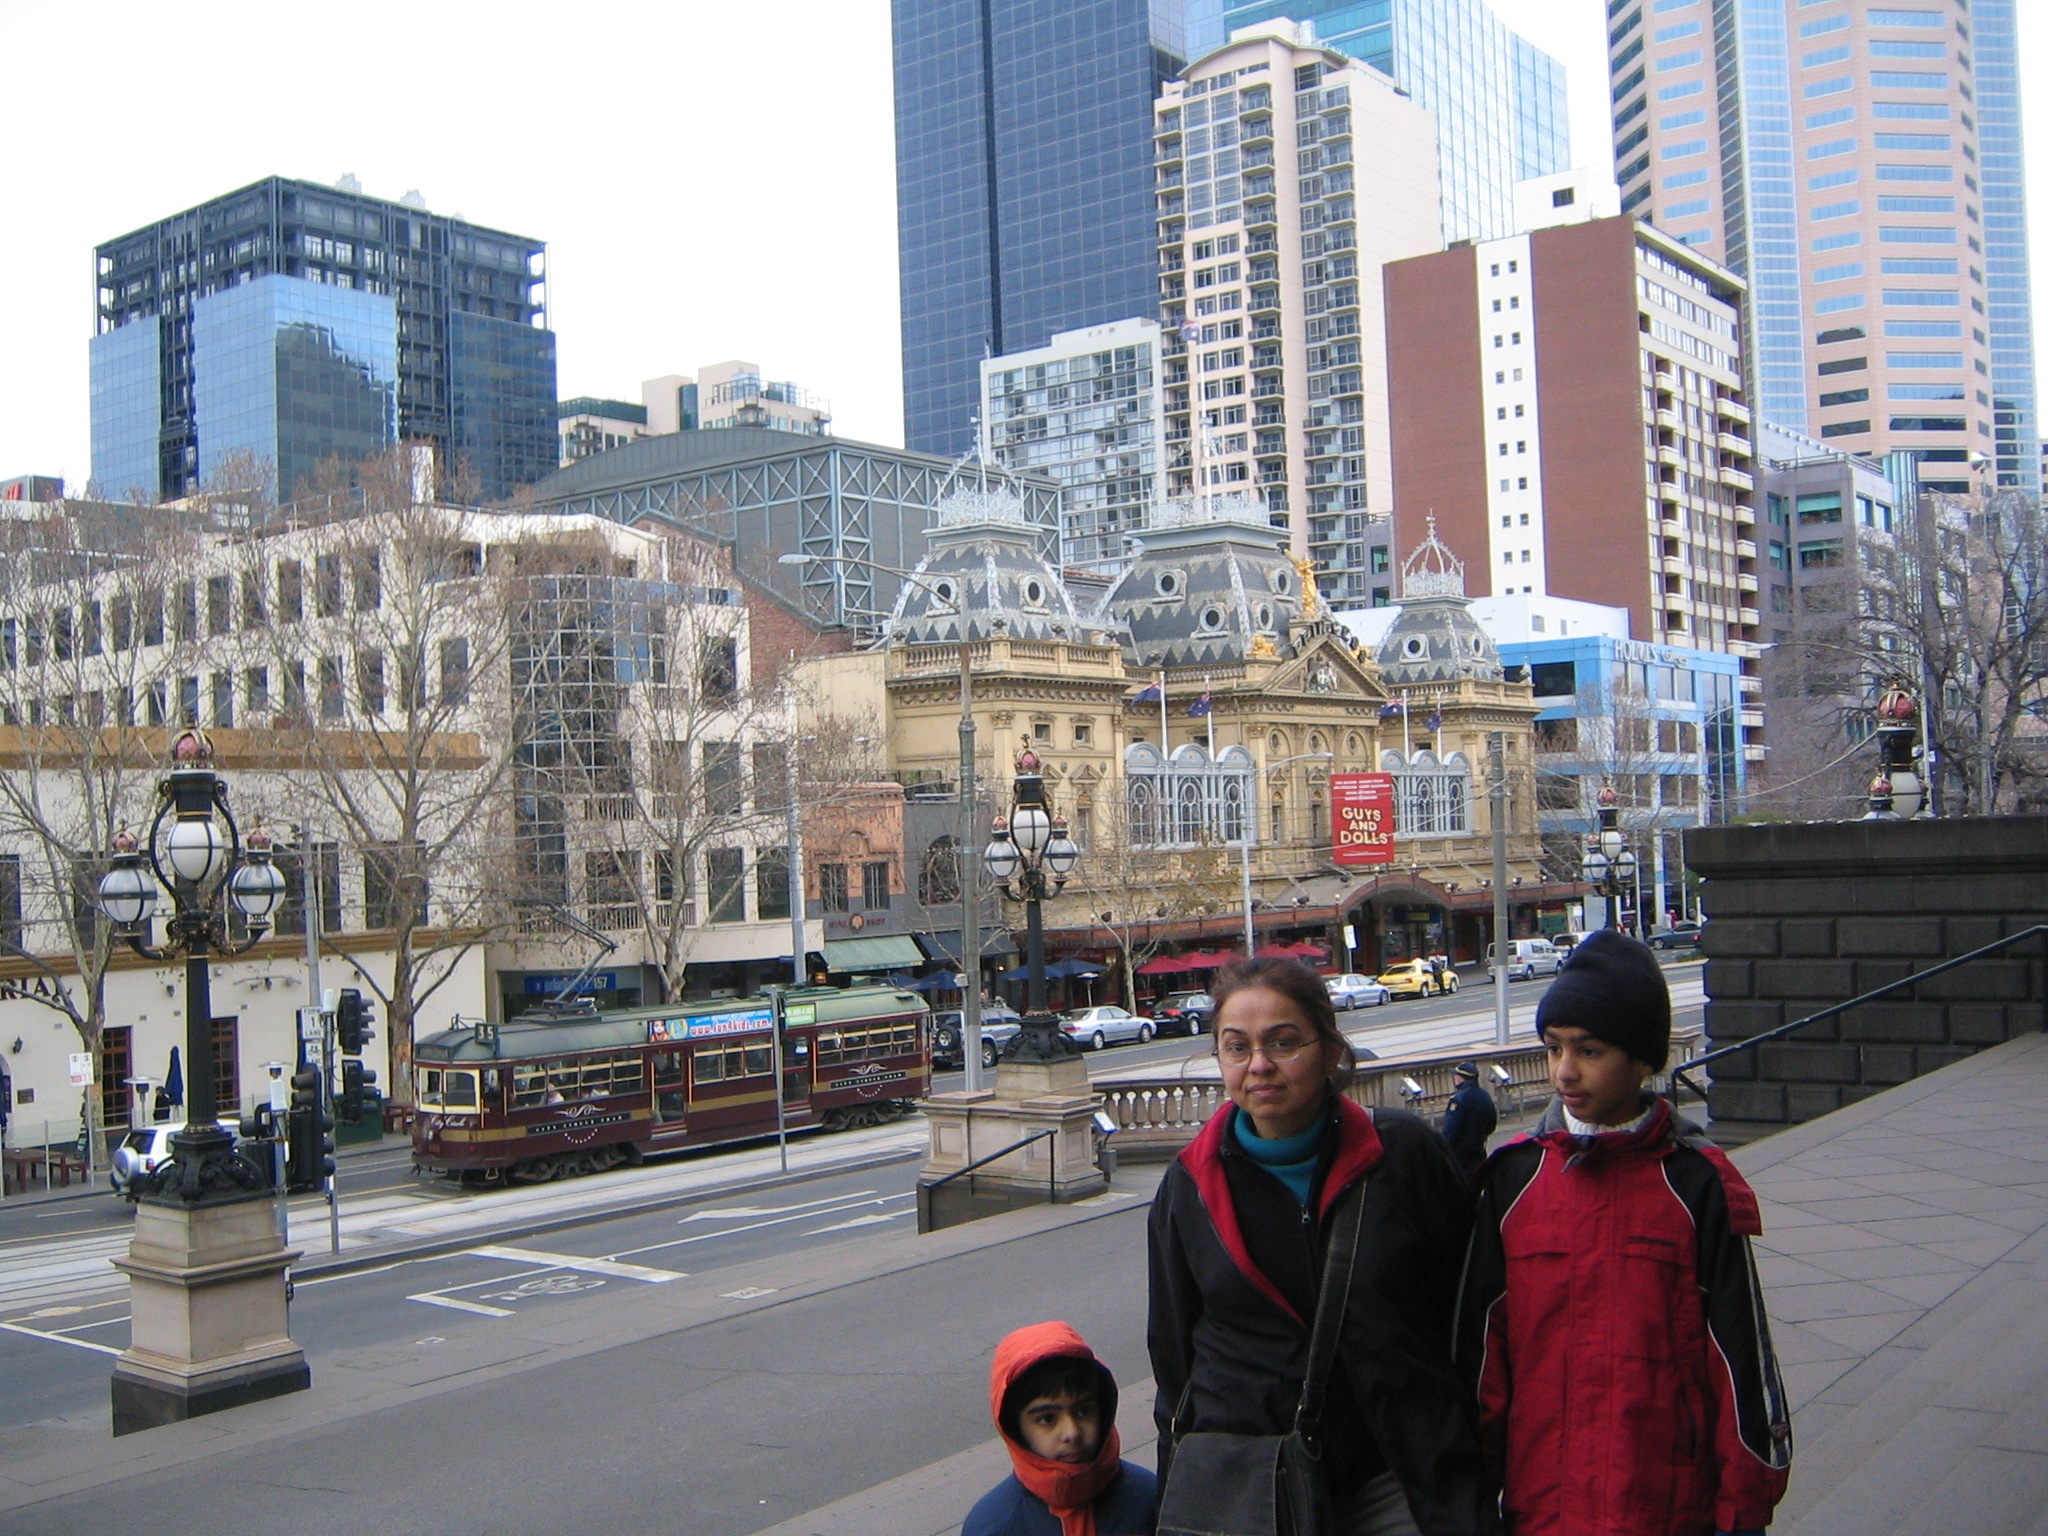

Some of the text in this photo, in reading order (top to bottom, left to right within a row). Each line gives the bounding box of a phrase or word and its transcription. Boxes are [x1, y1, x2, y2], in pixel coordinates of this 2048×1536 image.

[1615, 640, 1658, 664] HOLMES
[1342, 807, 1382, 822] GUYS
[1349, 819, 1378, 831] AND
[1340, 830, 1389, 845] DOLLS
[479, 1025, 495, 1040] 35
